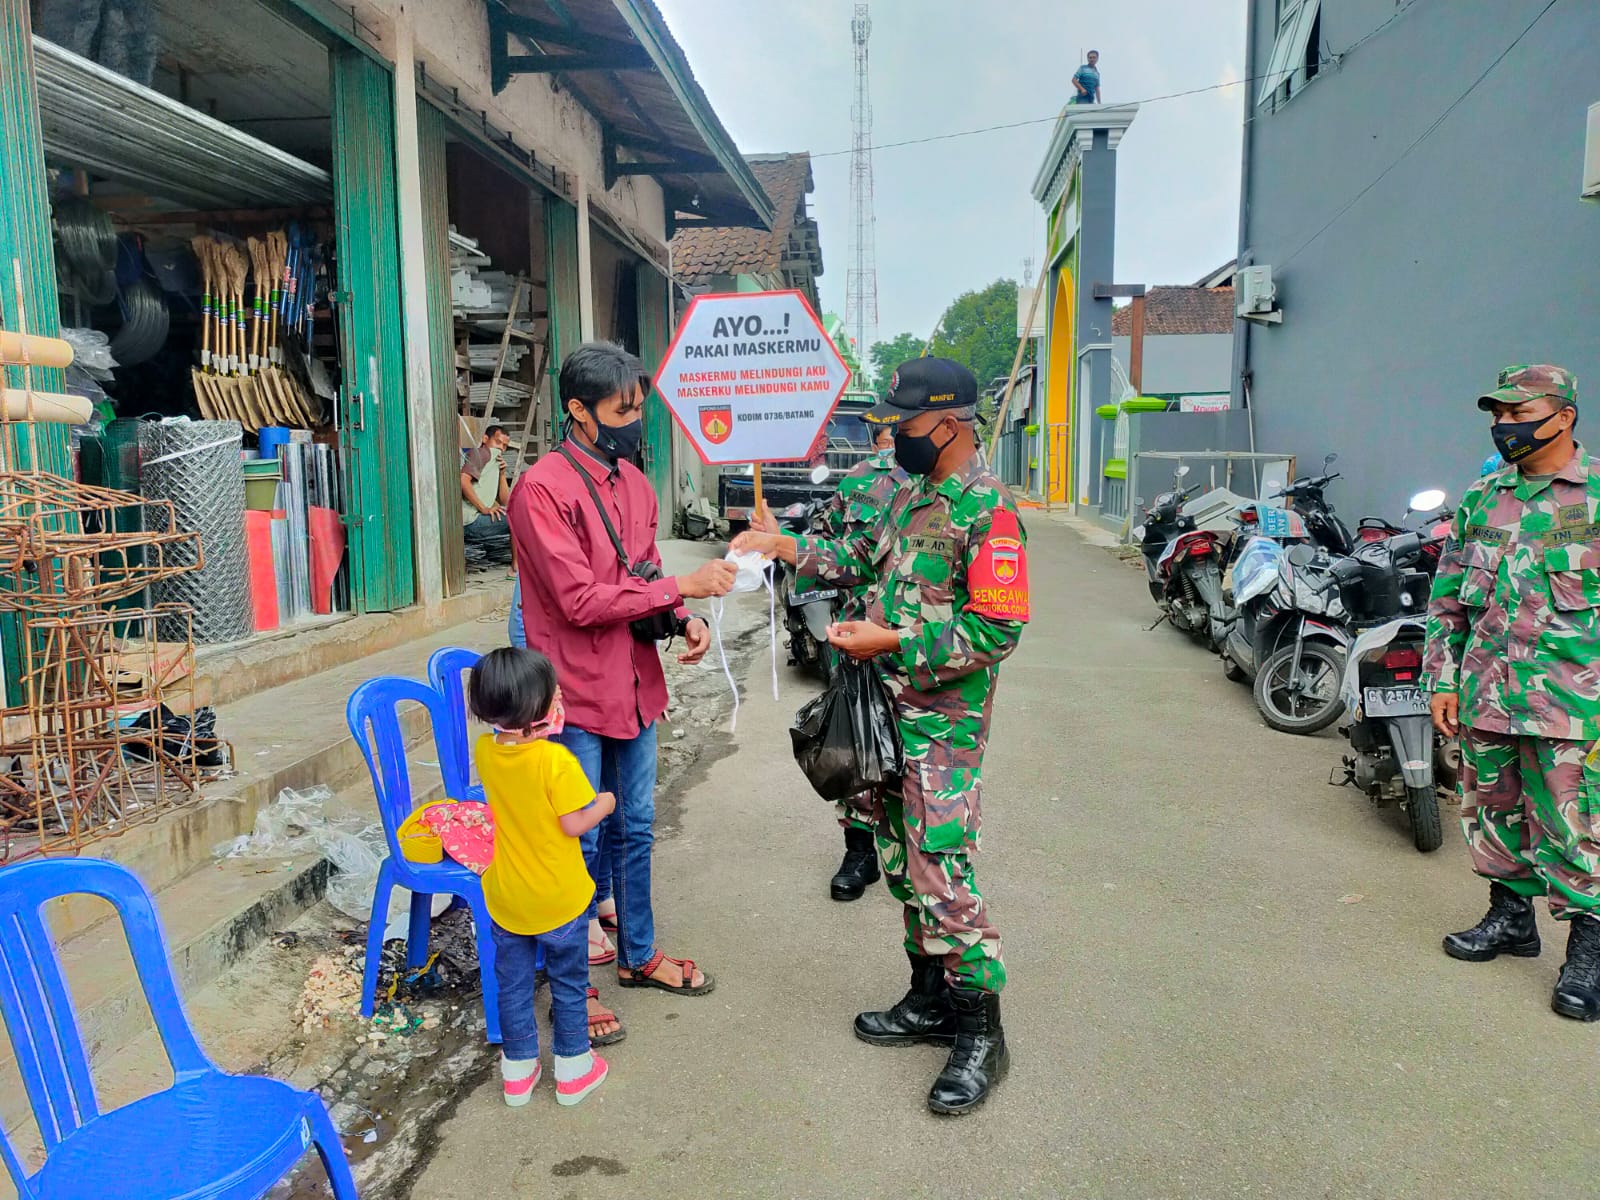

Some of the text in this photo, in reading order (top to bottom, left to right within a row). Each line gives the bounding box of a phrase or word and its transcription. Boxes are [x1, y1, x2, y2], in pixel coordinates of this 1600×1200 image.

[685, 338, 821, 359] PAKAI MASKERMU
[679, 365, 826, 383] MASKERMU MELINDUNGI AKU
[677, 381, 830, 398] MASKERKU MELINDUNGI KAMU
[737, 410, 815, 422] KODIM 0736/BATANG
